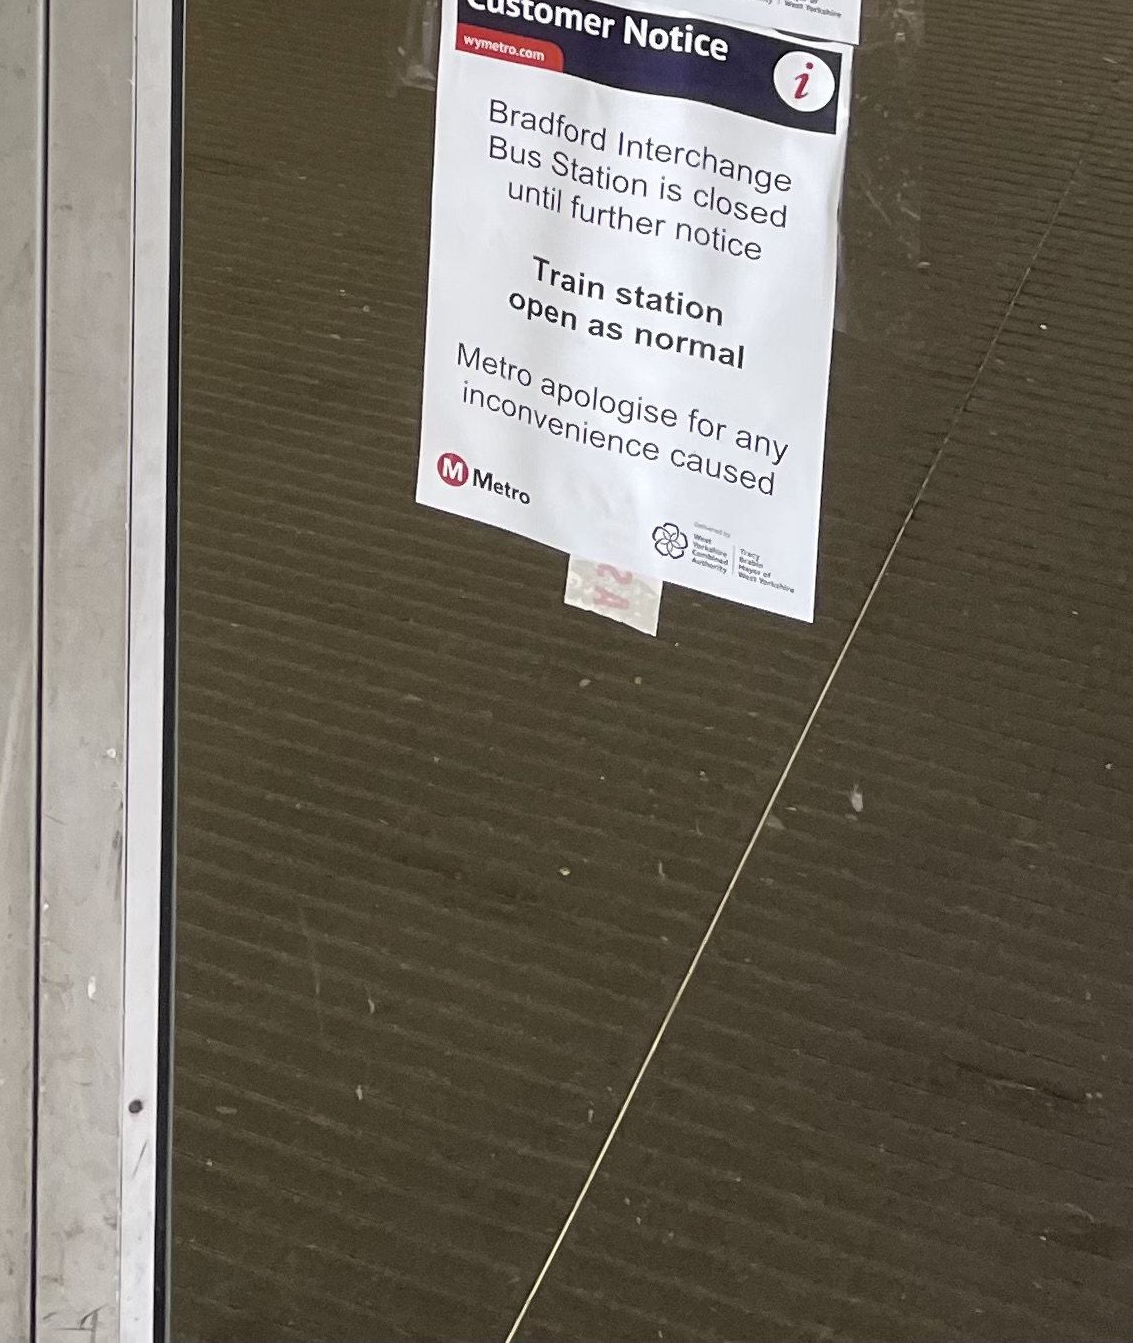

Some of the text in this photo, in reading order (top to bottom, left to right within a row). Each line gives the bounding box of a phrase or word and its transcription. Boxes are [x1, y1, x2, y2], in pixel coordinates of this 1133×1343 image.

[463, 35, 545, 62] wymetro.com
[623, 15, 729, 61] Notice
[489, 98, 792, 195] Bradford Interchange
[489, 134, 788, 229] Bus Station is closed
[508, 181, 762, 261] until further notice
[532, 255, 723, 327] Train station
[508, 292, 745, 370] open as normal
[457, 341, 789, 466] Metro apologise for any
[463, 380, 775, 496] inconvenience caused
[472, 467, 531, 505] Metro
